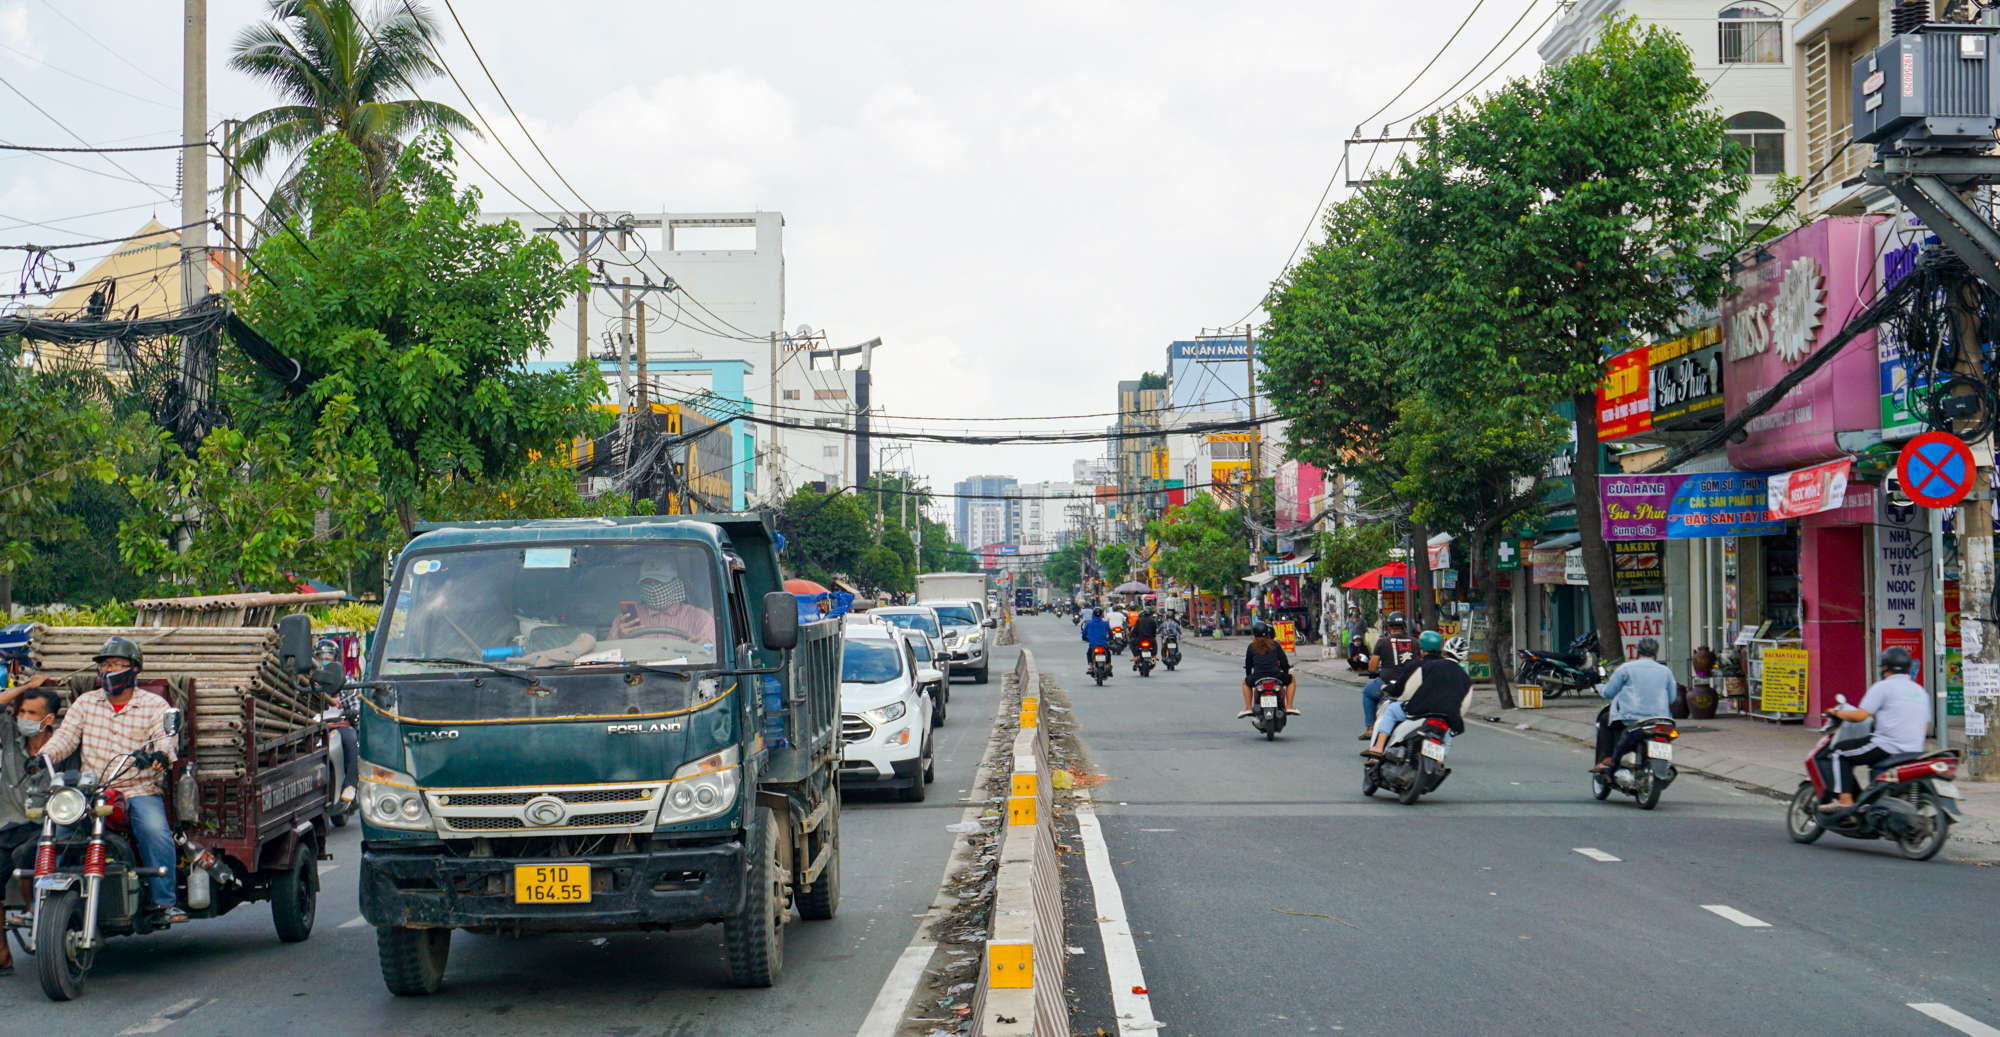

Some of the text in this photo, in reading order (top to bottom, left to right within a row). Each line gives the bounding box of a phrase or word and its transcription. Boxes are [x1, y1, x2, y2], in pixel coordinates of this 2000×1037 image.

[1904, 55, 1913, 96] 192560293
[1658, 357, 1707, 407] Gia Phúc
[1608, 481, 1665, 494] CỬA HÀNG
[1700, 477, 1720, 491] GỐM
[1690, 495, 1707, 508] CÁC
[1709, 493, 1726, 507] SẢN
[1729, 491, 1753, 506] PHẨM
[1607, 502, 1667, 520] Gia Phúc
[1684, 511, 1709, 527] ĐẶC
[1711, 510, 1735, 524] SẢN
[1738, 510, 1758, 523] TÂY
[1613, 523, 1656, 536] Cung Cấp
[1889, 528, 1912, 542] NHÀ
[1616, 542, 1657, 553] BAKERY
[1883, 544, 1919, 559] THUỐC
[1890, 561, 1911, 576] TÂY
[1887, 581, 1916, 595] NGỌC
[1618, 599, 1663, 614] NHÀ MAY
[1888, 598, 1915, 610] MINH
[1619, 616, 1663, 637] NHẬT
[1898, 613, 1905, 626] 2
[408, 730, 459, 742] THACO
[607, 723, 682, 735] FORLAND
[537, 868, 568, 883] 51D
[526, 885, 582, 901] 164.55
